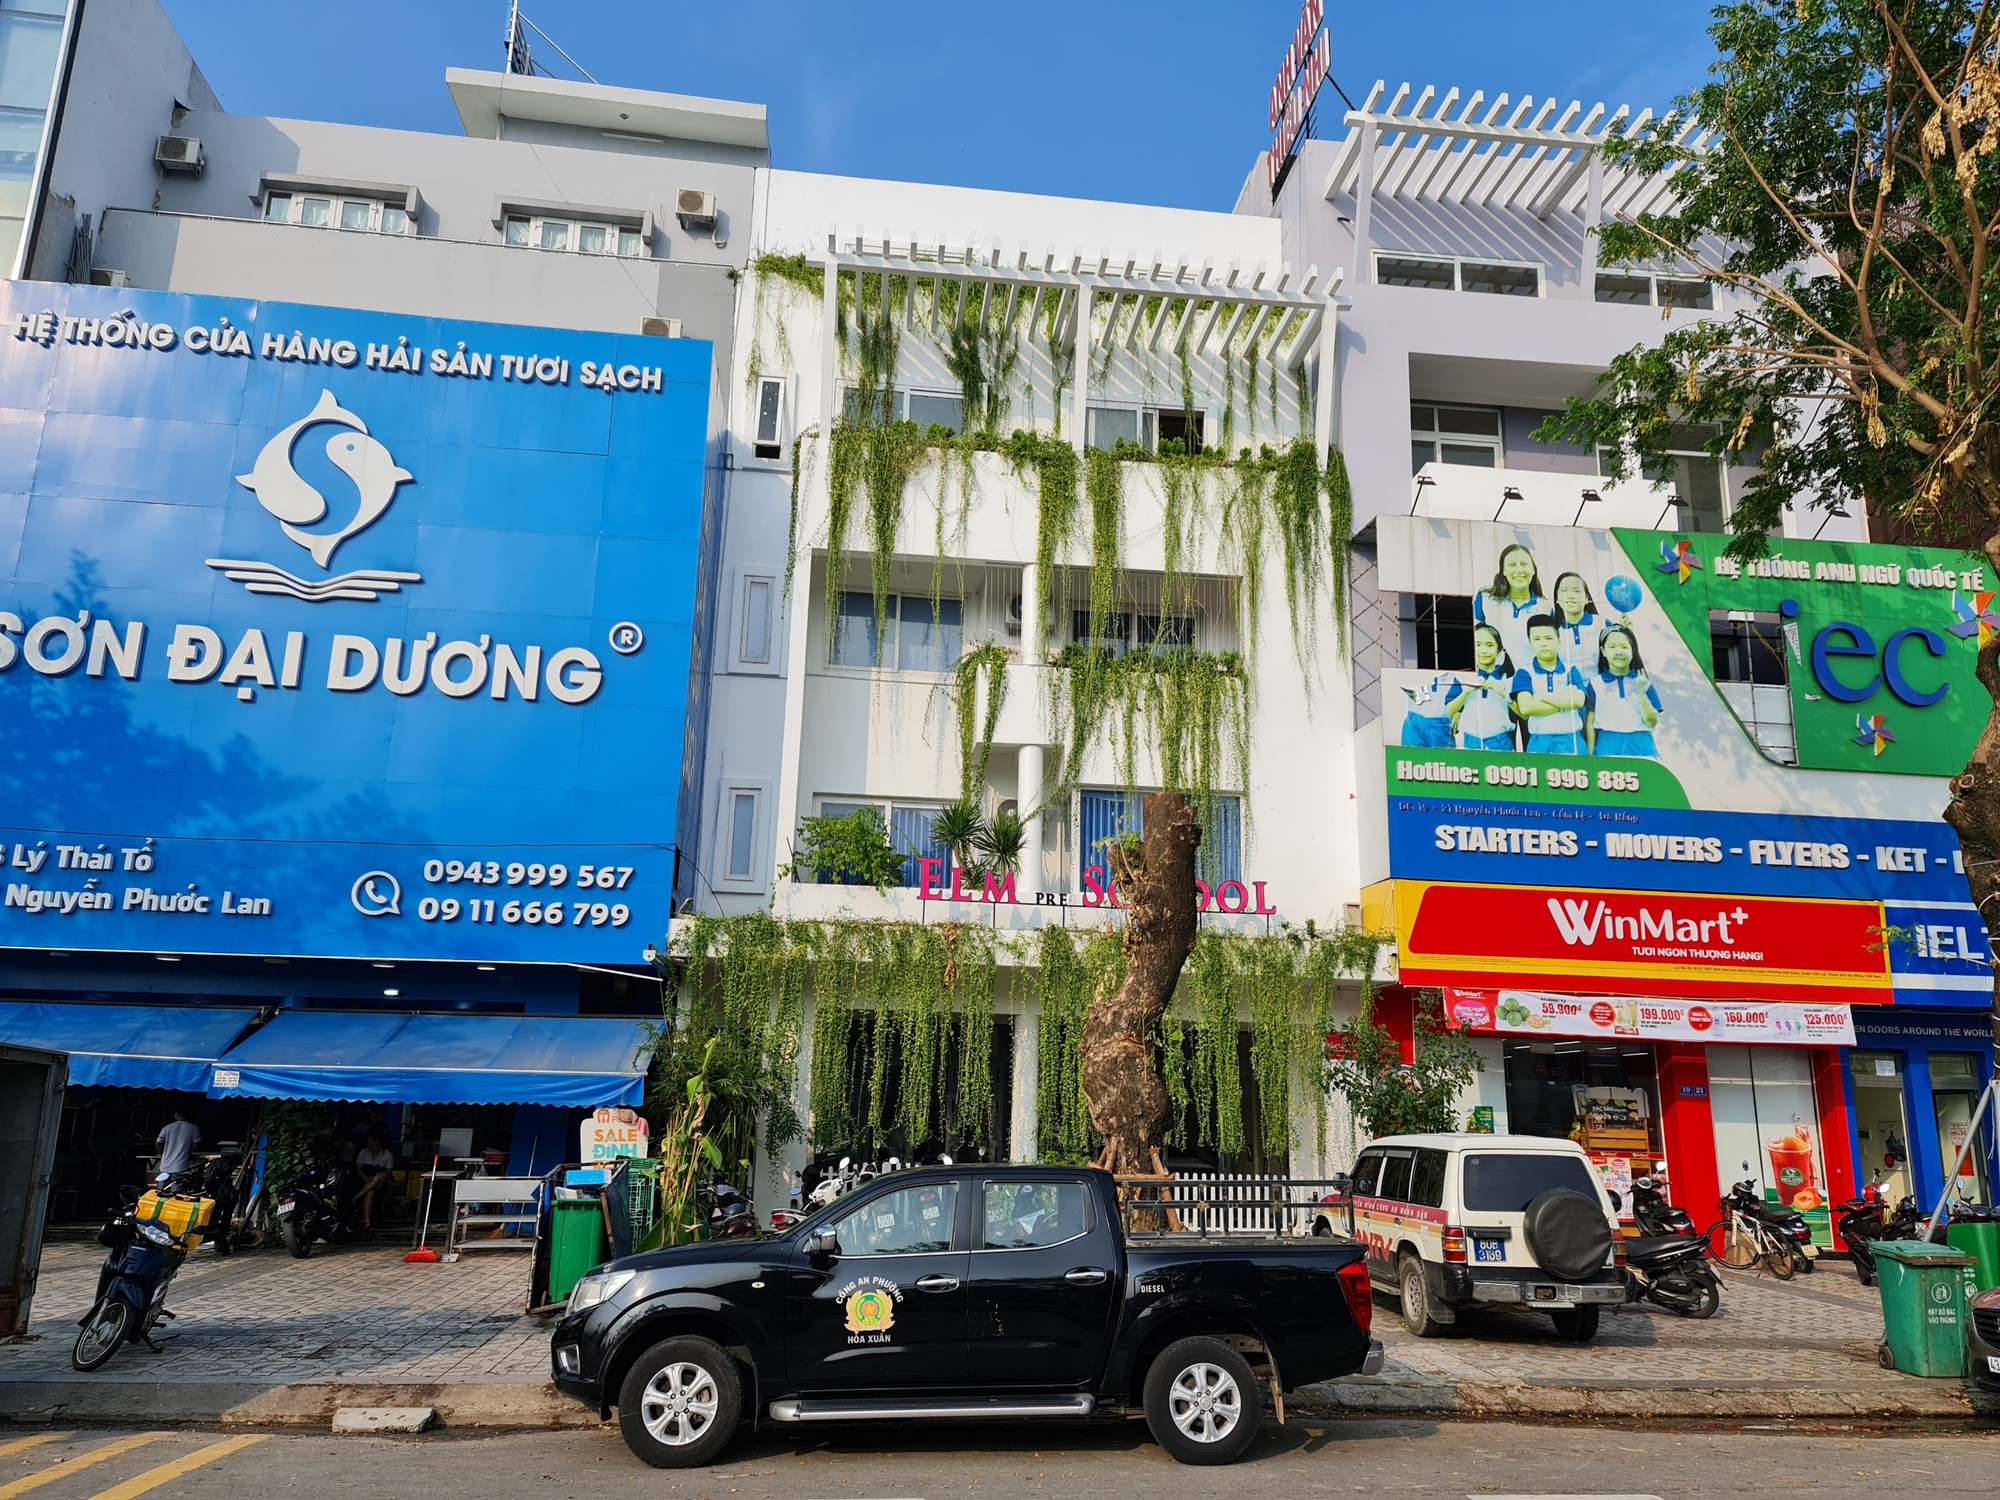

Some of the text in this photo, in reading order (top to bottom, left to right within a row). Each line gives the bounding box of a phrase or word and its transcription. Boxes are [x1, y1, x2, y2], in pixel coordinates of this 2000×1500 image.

[14, 307, 662, 391] HỆ THỐNG CỬA HÀNG HẢI SẢN TƯƠI SẠCH
[1747, 553, 1811, 580] THỐNG
[1815, 562, 1856, 582] ANH
[1859, 563, 1902, 586] NGỮ
[1905, 563, 1957, 589] QUỐC
[1959, 567, 1984, 592] TẾ
[166, 624, 304, 700] ĐẠI
[327, 631, 603, 704] DƯƠNG
[1397, 760, 1640, 791] Hotline: 0901 996 885
[12, 841, 47, 873] Lý
[56, 844, 113, 871] Thái
[121, 837, 155, 871] Tổ
[1435, 825, 1578, 856] STARTERS
[1606, 833, 1722, 862] MOVERS
[1749, 840, 1849, 868] FLYERS
[1876, 846, 1927, 873] KET
[424, 860, 633, 889] 0943 999 567
[916, 857, 1020, 904] ELM
[1035, 892, 1067, 906] PRE
[5, 878, 271, 915] Nguyễn Phước Lan
[502, 901, 563, 924] 666
[572, 903, 630, 926] 799
[1657, 948, 1688, 957] NGON
[1733, 951, 1764, 961] HẠNG!
[1915, 924, 1989, 960] IEL
[1854, 1025, 1866, 1033] EN
[1867, 1026, 1900, 1034] DOORS
[1902, 1027, 1941, 1036] AROUND
[1943, 1028, 1960, 1036] THE
[594, 1128, 638, 1143] SALE
[835, 1276, 904, 1304] CÔNG AN PHƯỜNG
[1141, 1284, 1165, 1293] DIESEL
[847, 1333, 891, 1344] HÒA XUÂN
